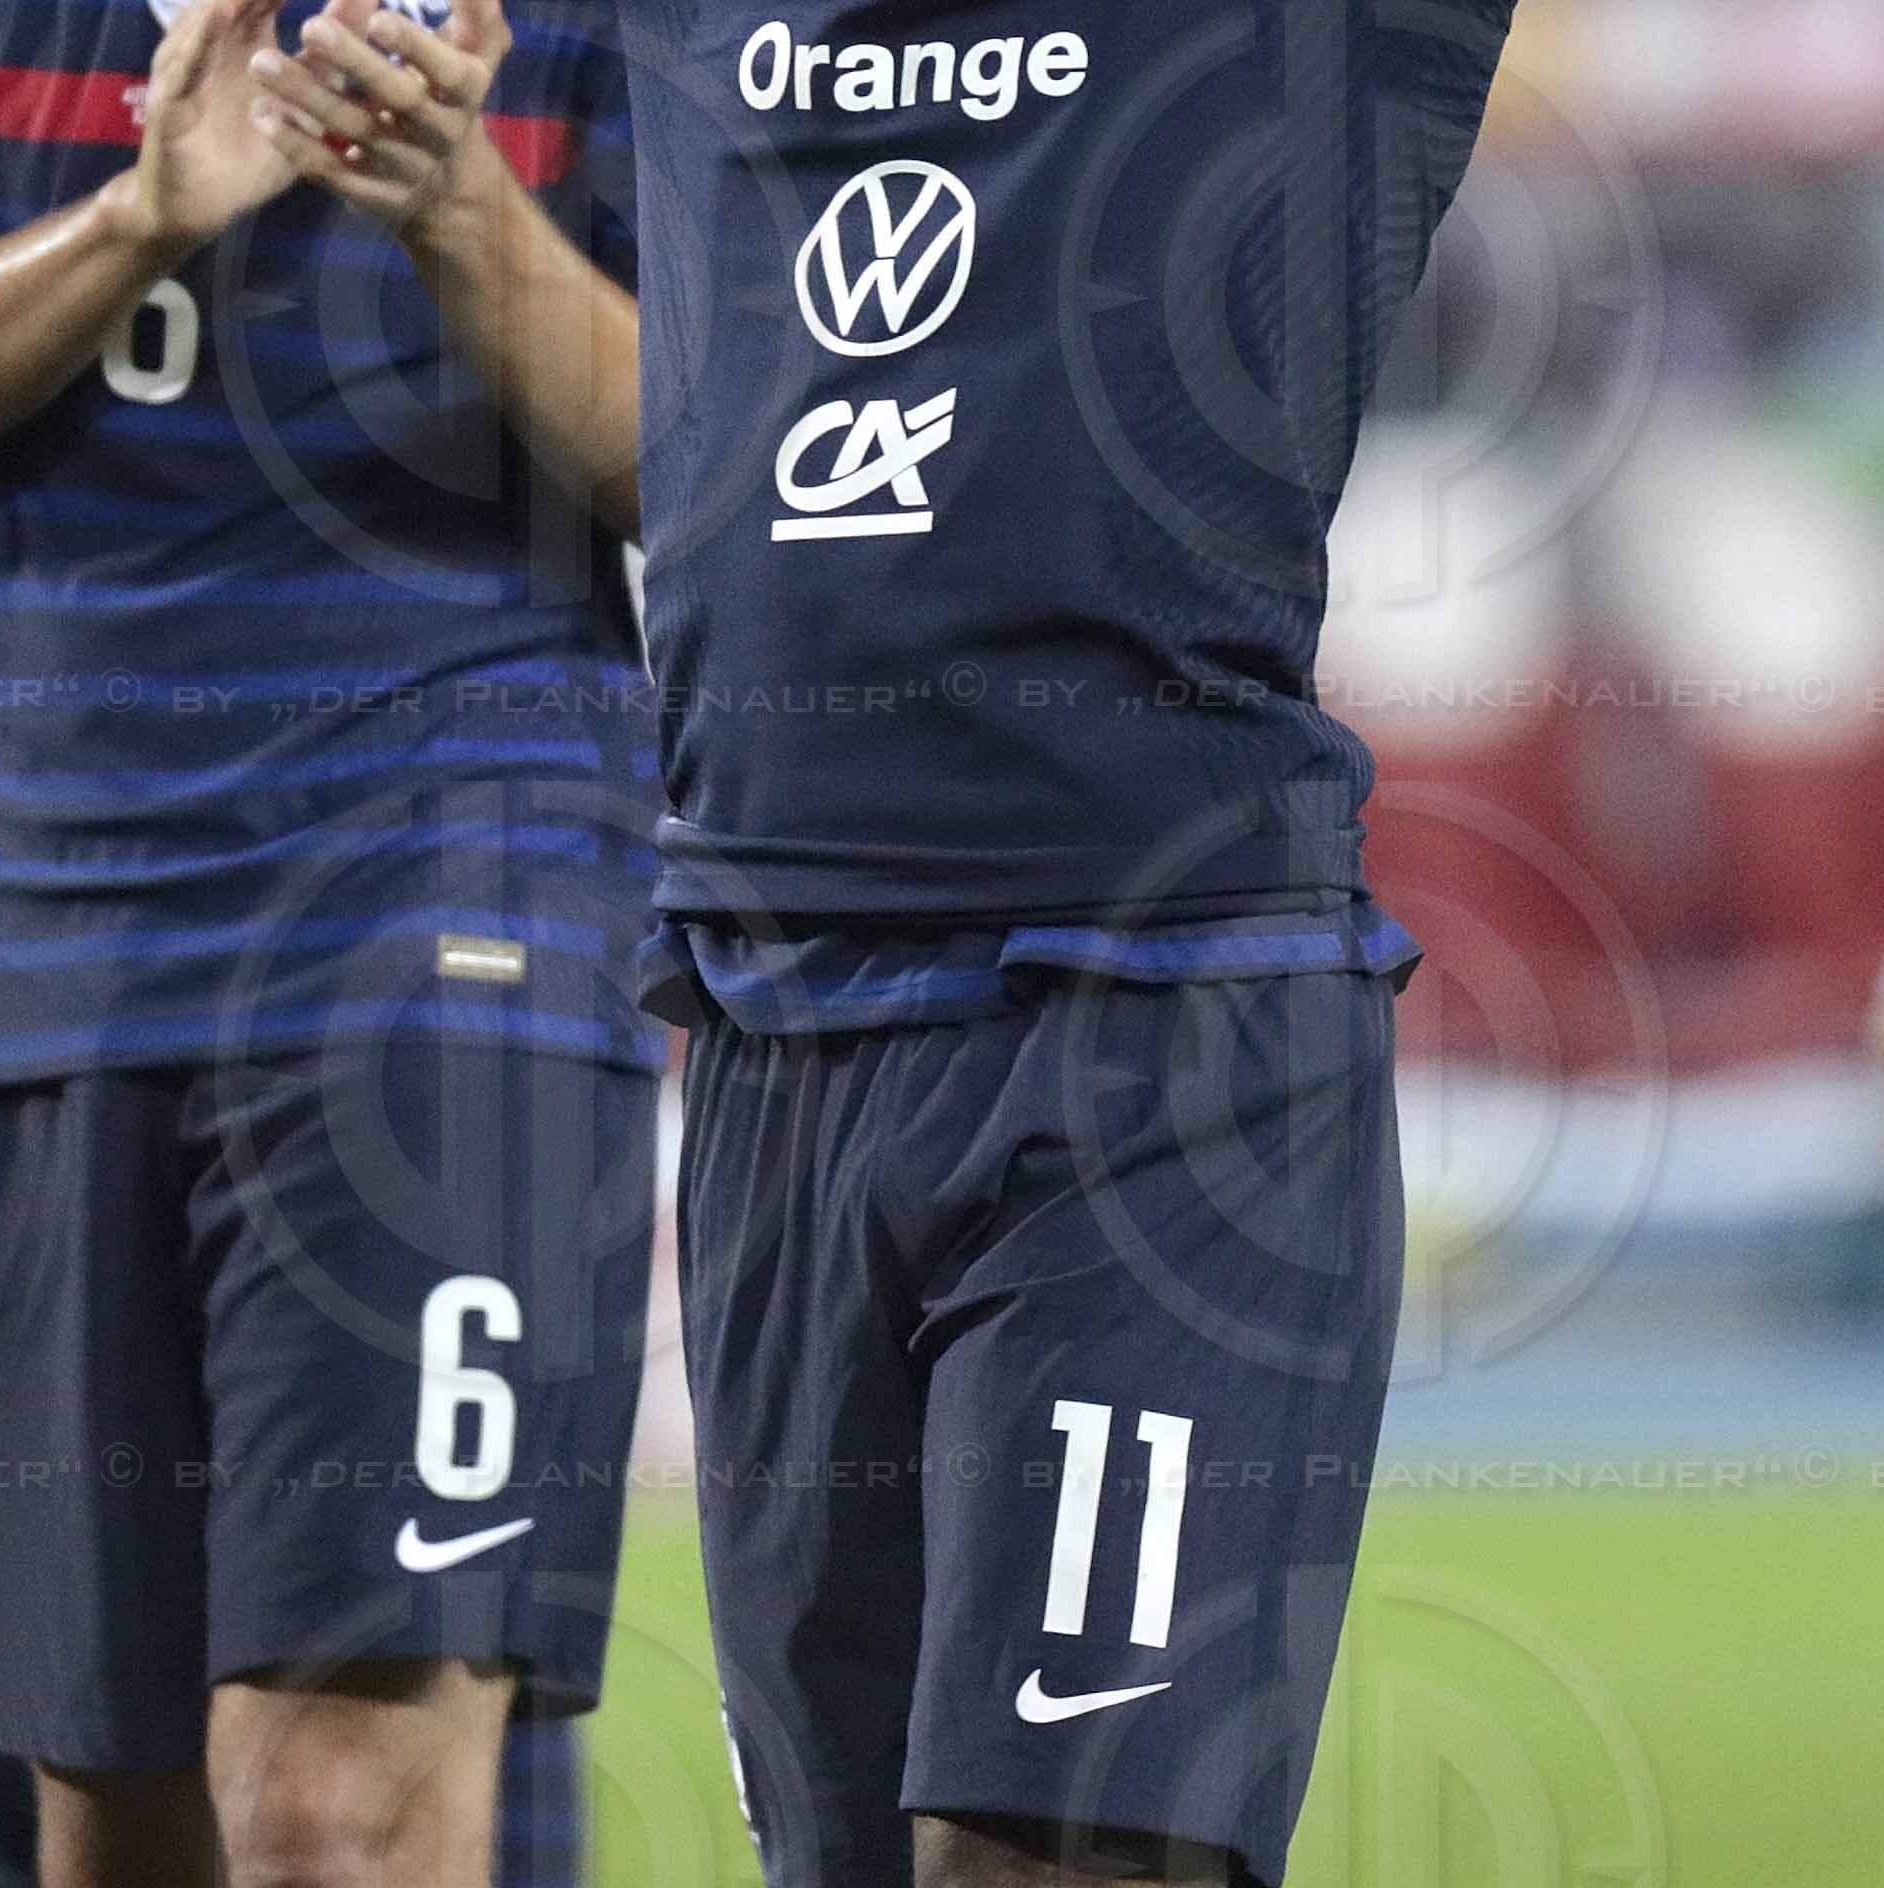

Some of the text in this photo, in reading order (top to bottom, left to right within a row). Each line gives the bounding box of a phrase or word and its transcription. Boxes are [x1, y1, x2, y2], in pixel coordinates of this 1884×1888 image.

[737, 19, 1090, 122] Orange
[415, 1275, 521, 1501] 6
[1042, 1399, 1194, 1649] 11
